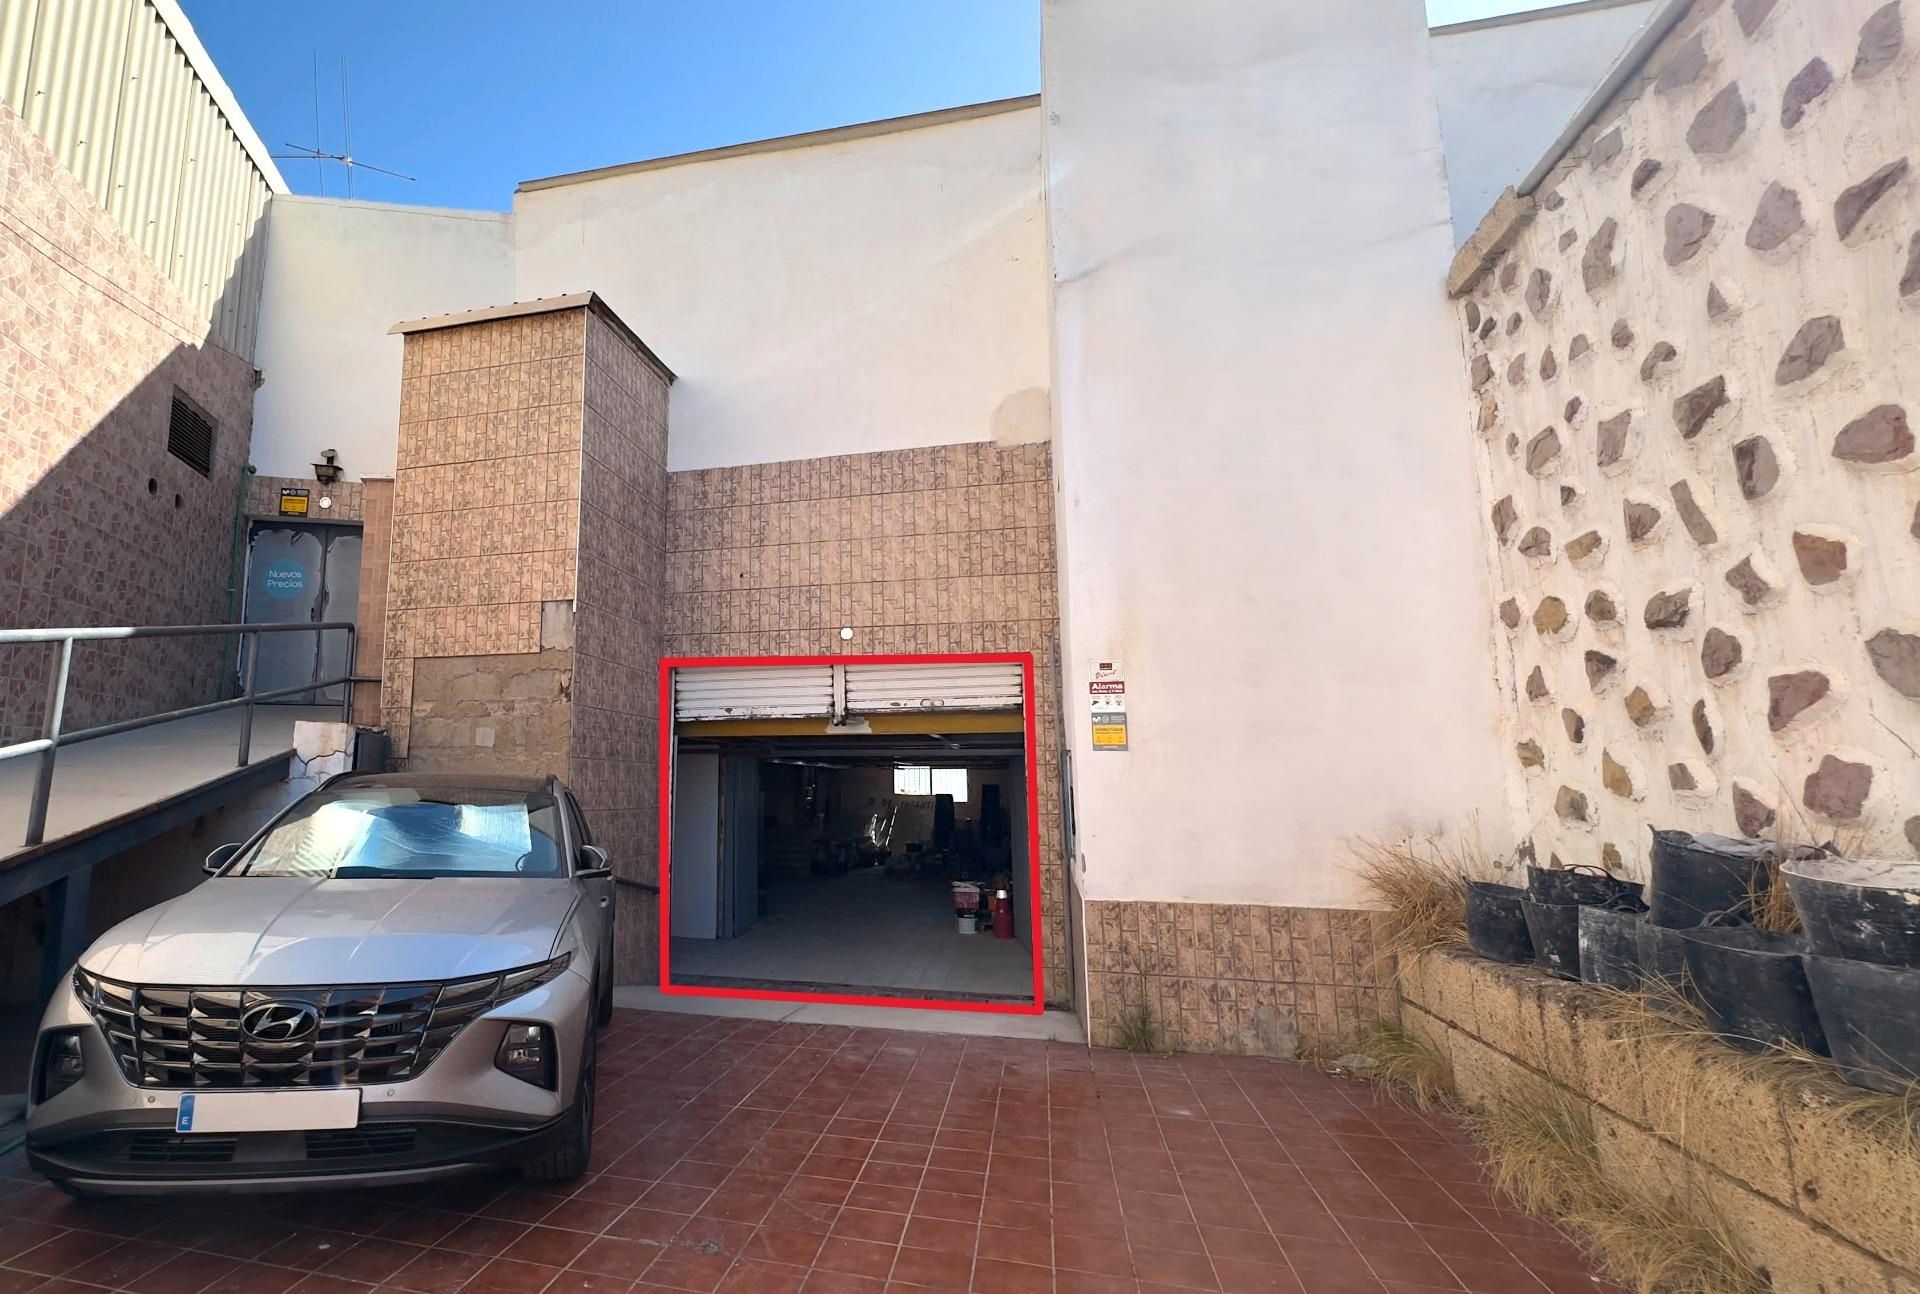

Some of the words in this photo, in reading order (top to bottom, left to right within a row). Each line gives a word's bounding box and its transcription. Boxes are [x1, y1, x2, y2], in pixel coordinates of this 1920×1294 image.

[269, 570, 302, 579] Nuevos
[267, 579, 304, 588] Precios
[182, 1116, 189, 1125] E
